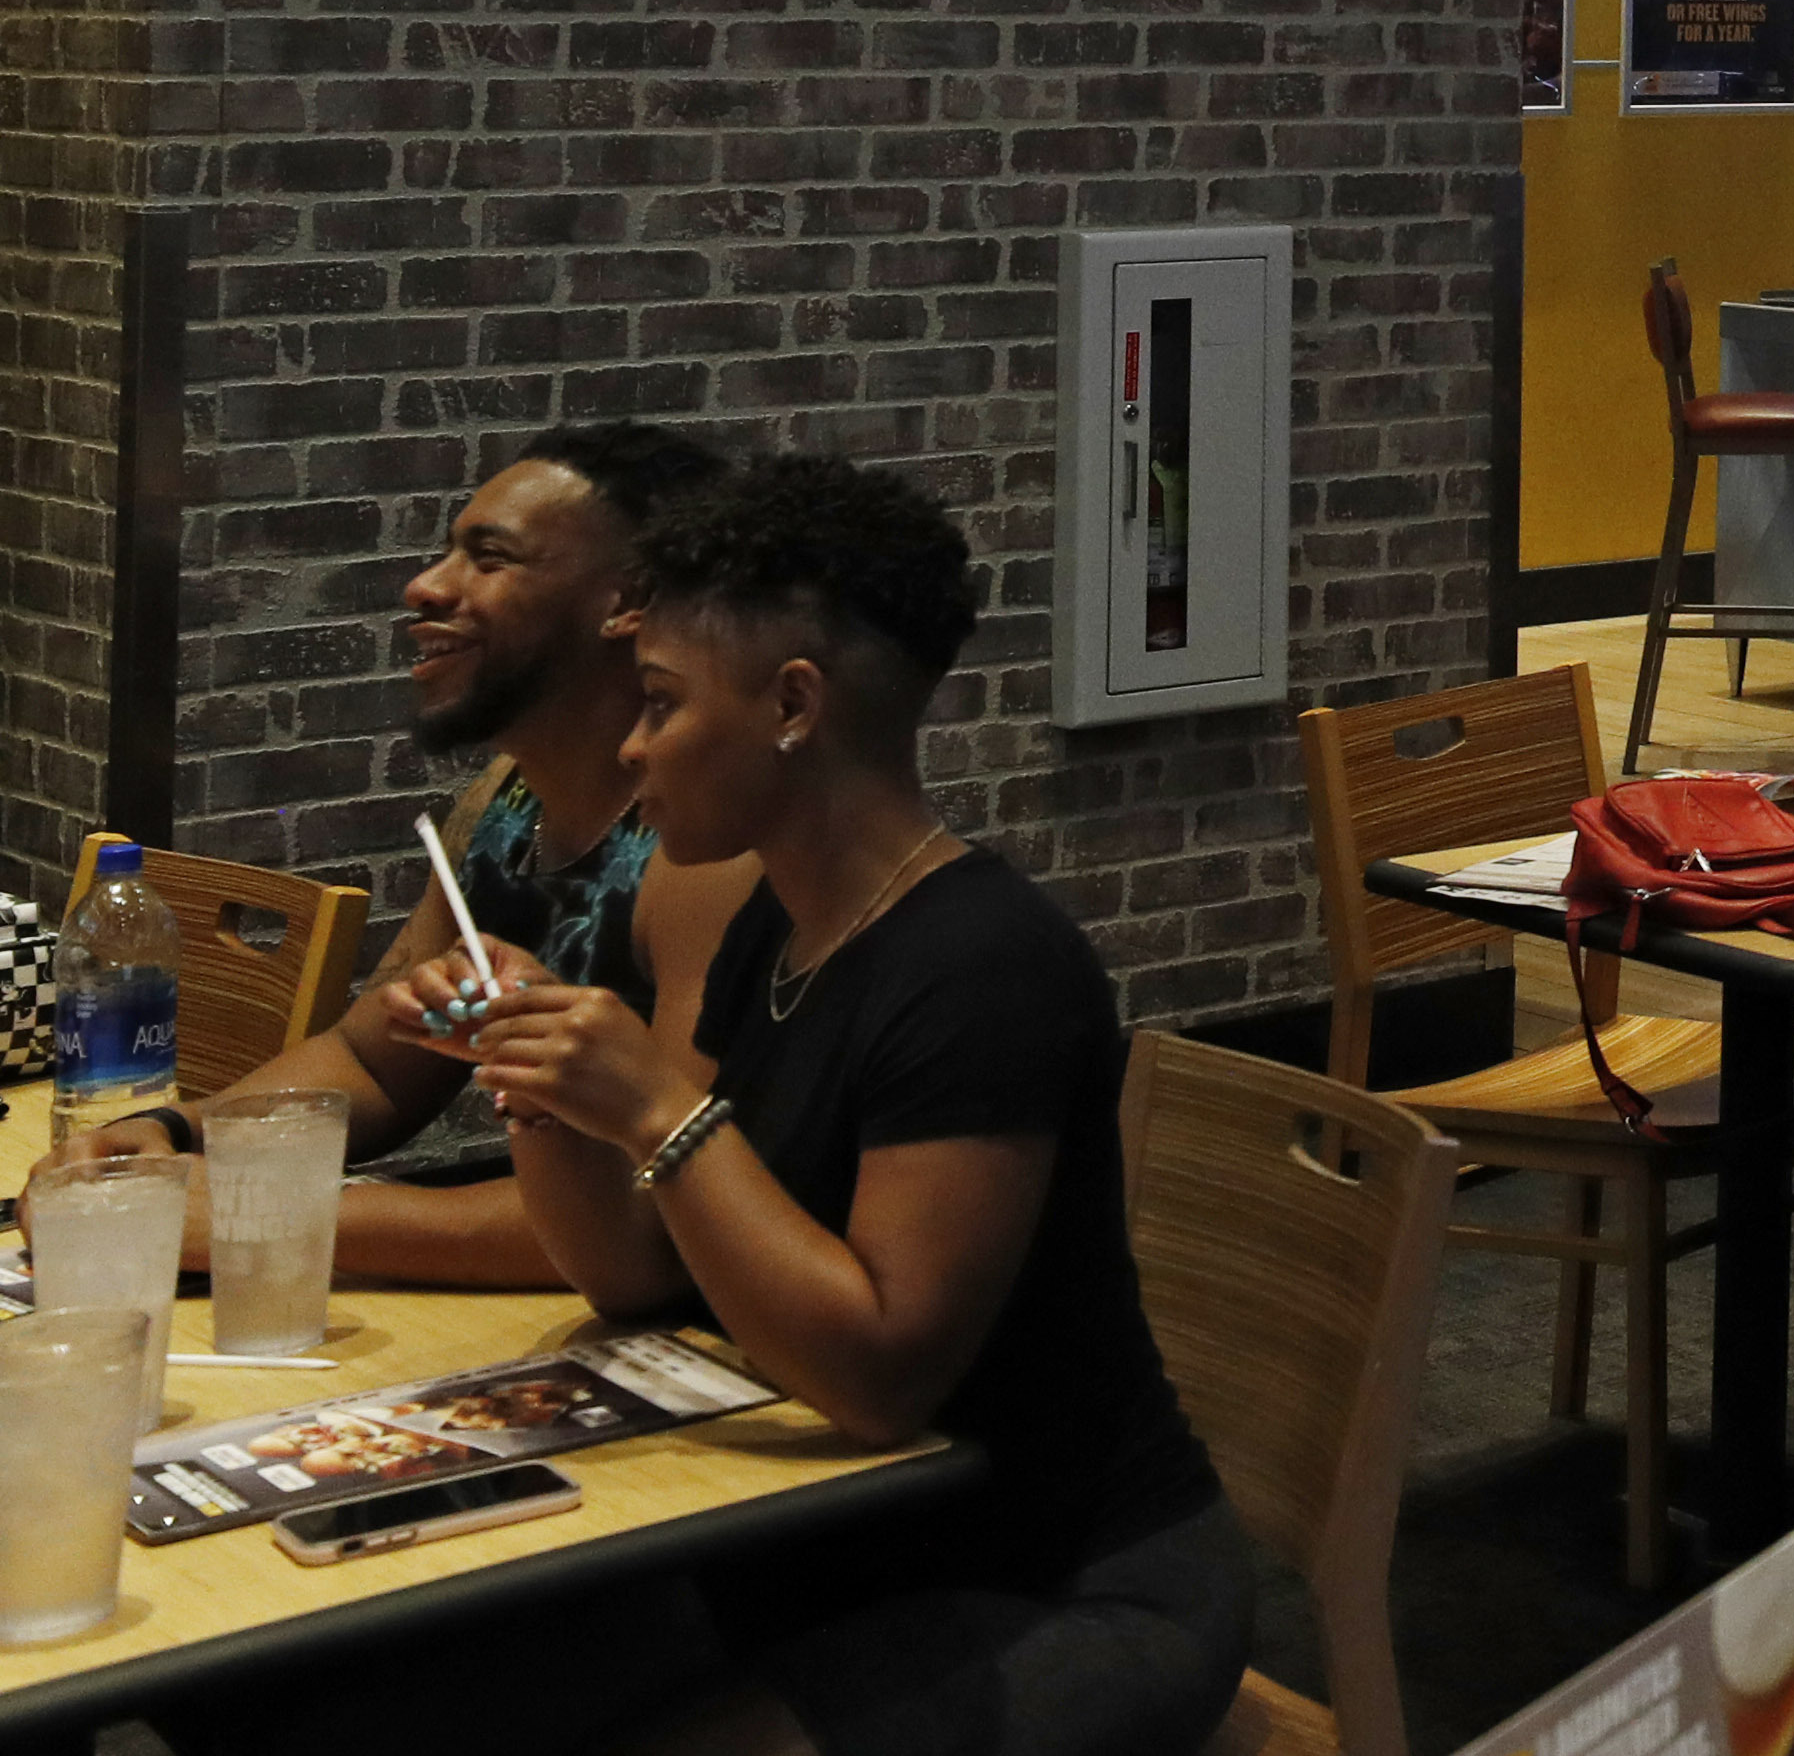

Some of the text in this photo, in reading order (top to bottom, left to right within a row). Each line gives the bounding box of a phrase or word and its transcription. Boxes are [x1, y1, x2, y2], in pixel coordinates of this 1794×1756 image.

[1667, 3, 1767, 23] OR FREE WINGS
[1676, 24, 1701, 43] FOR
[1702, 24, 1714, 42] A
